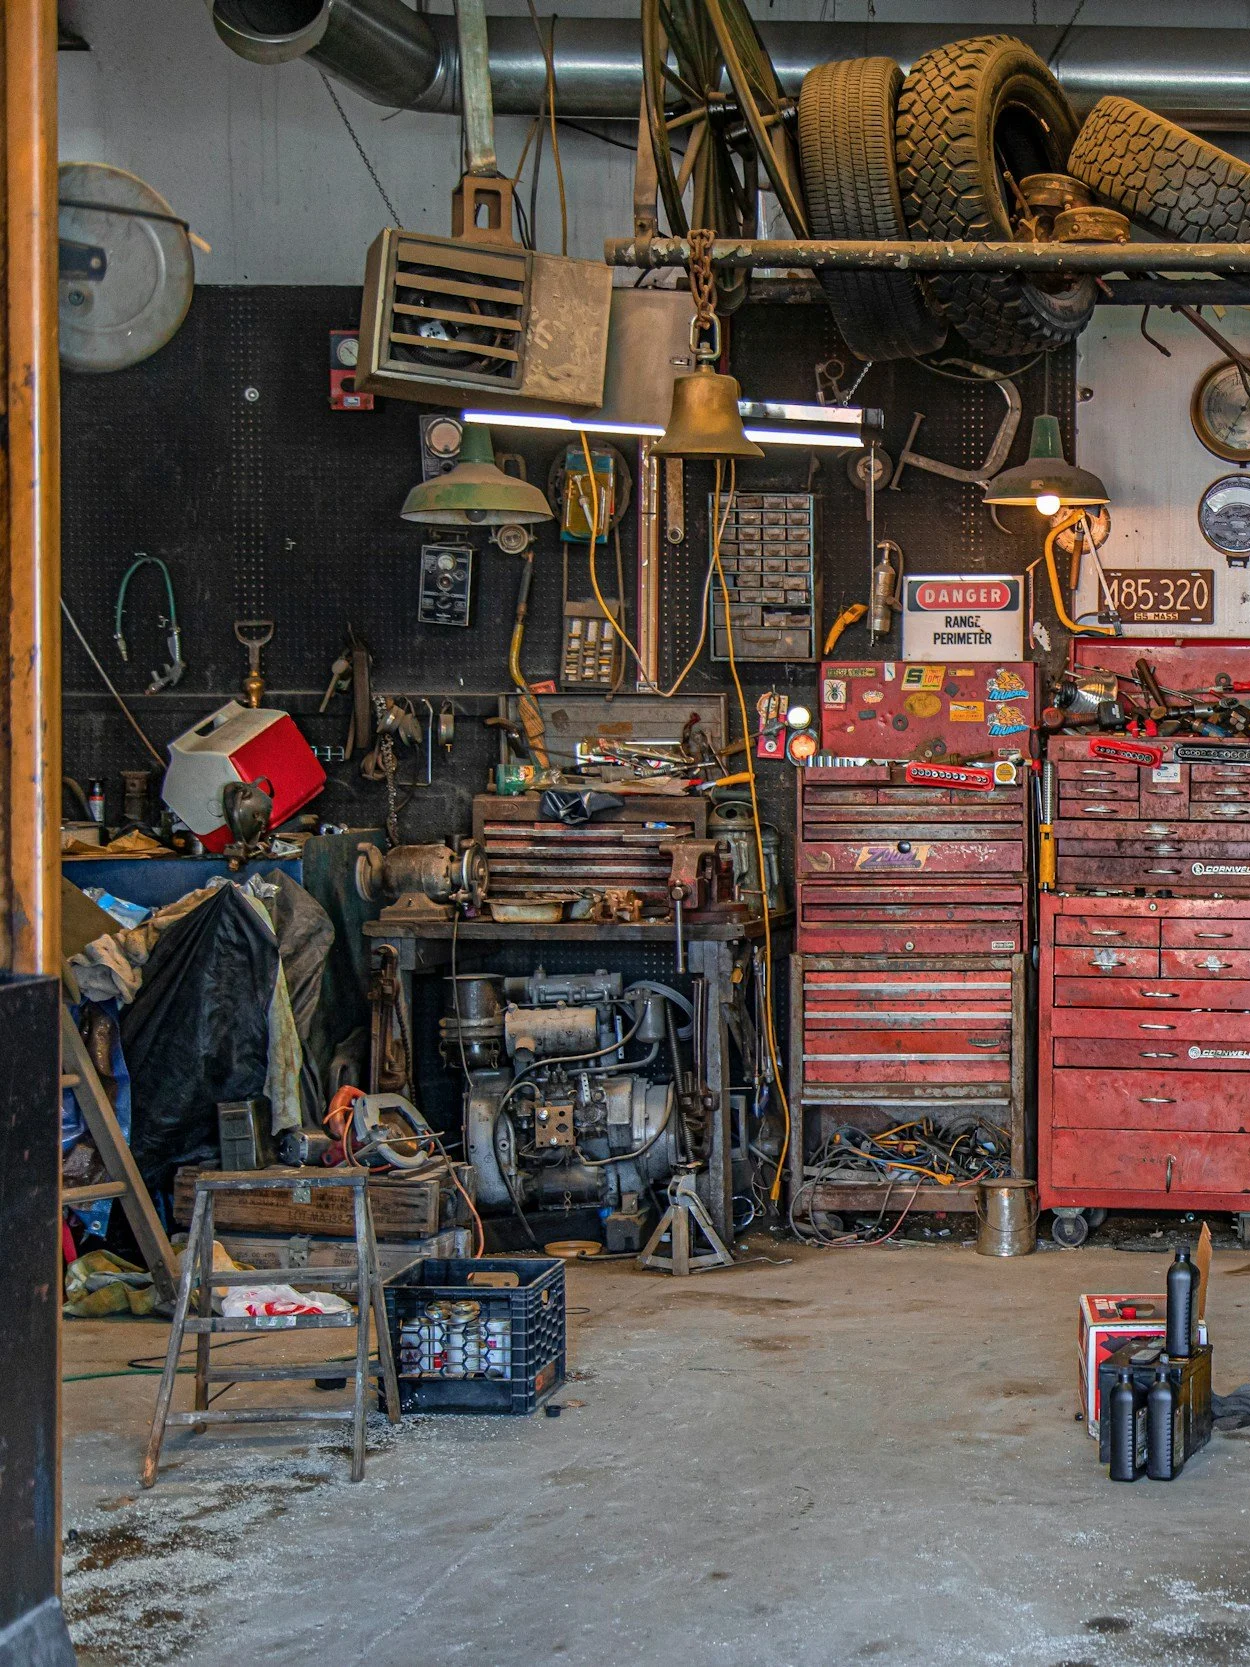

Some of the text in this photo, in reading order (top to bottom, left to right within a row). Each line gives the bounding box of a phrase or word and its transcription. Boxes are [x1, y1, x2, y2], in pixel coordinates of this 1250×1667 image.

[924, 587, 1001, 603] DANGER
[945, 615, 981, 629] RANGE
[1153, 613, 1179, 621] MASS
[933, 632, 992, 646] PERIMETER
